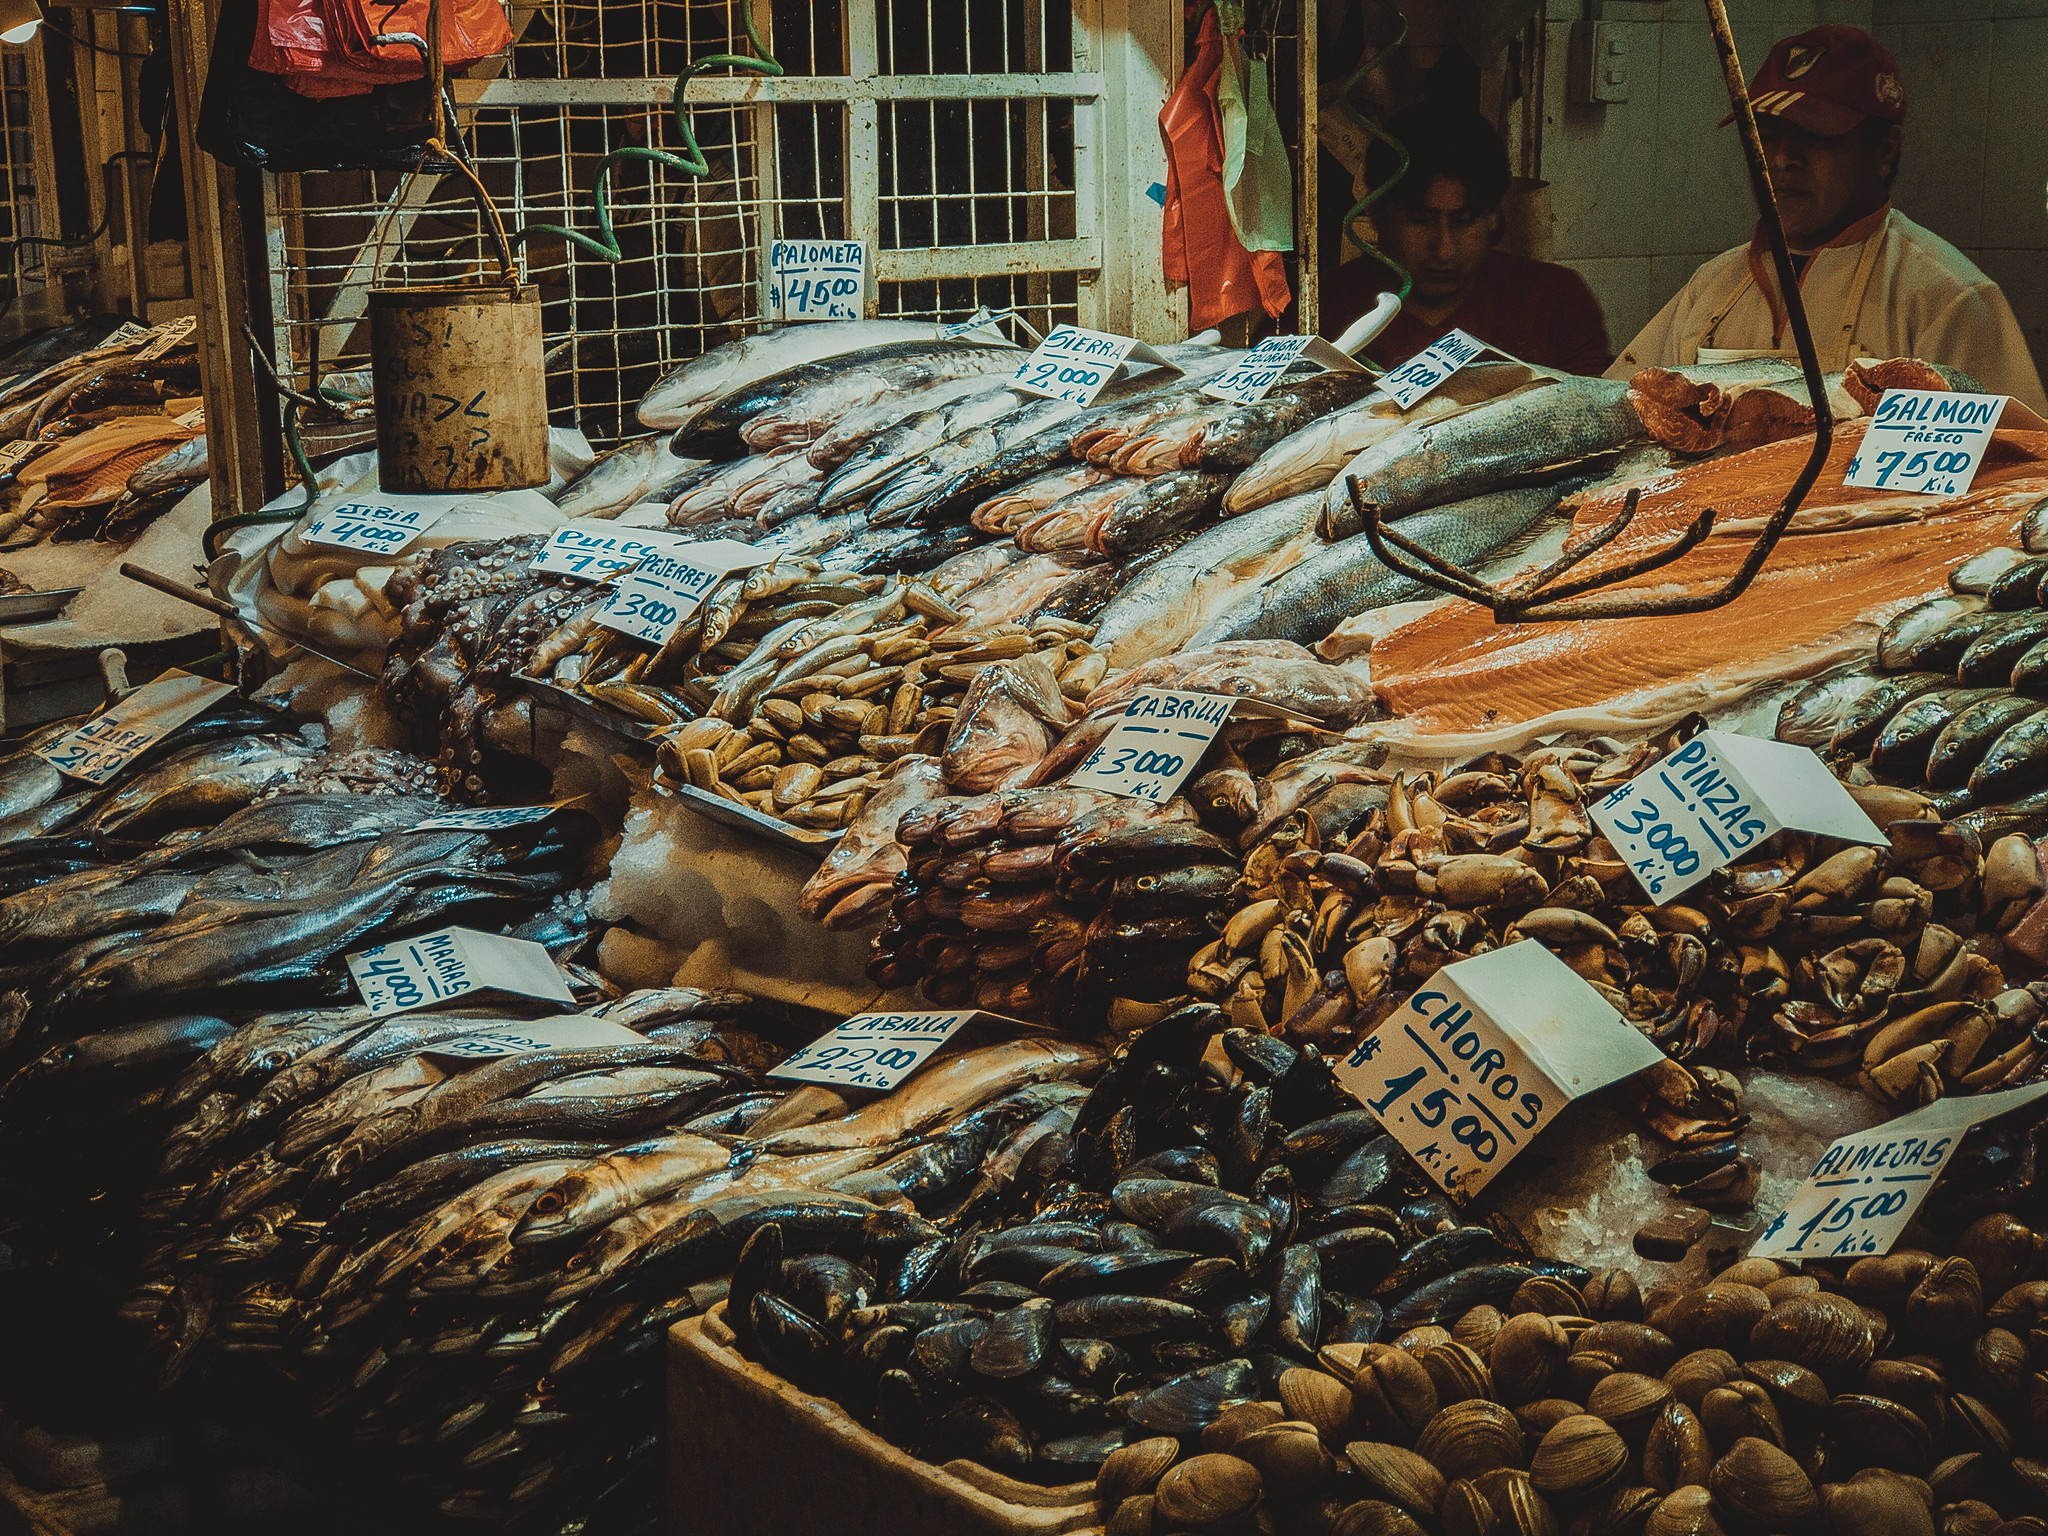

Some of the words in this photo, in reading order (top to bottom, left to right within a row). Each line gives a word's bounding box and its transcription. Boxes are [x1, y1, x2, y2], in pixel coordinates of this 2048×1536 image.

[772, 243, 862, 267] PALOMETA
[1874, 393, 1999, 425] SALMON
[1903, 431, 1963, 445] FRESCO
[637, 553, 718, 594] PEJERREY
[418, 934, 471, 996] MACHAS
[836, 1015, 958, 1033] CABALLA
[1411, 991, 1543, 1130] CHOROS
[1810, 1137, 1952, 1178] ALMEJAS
